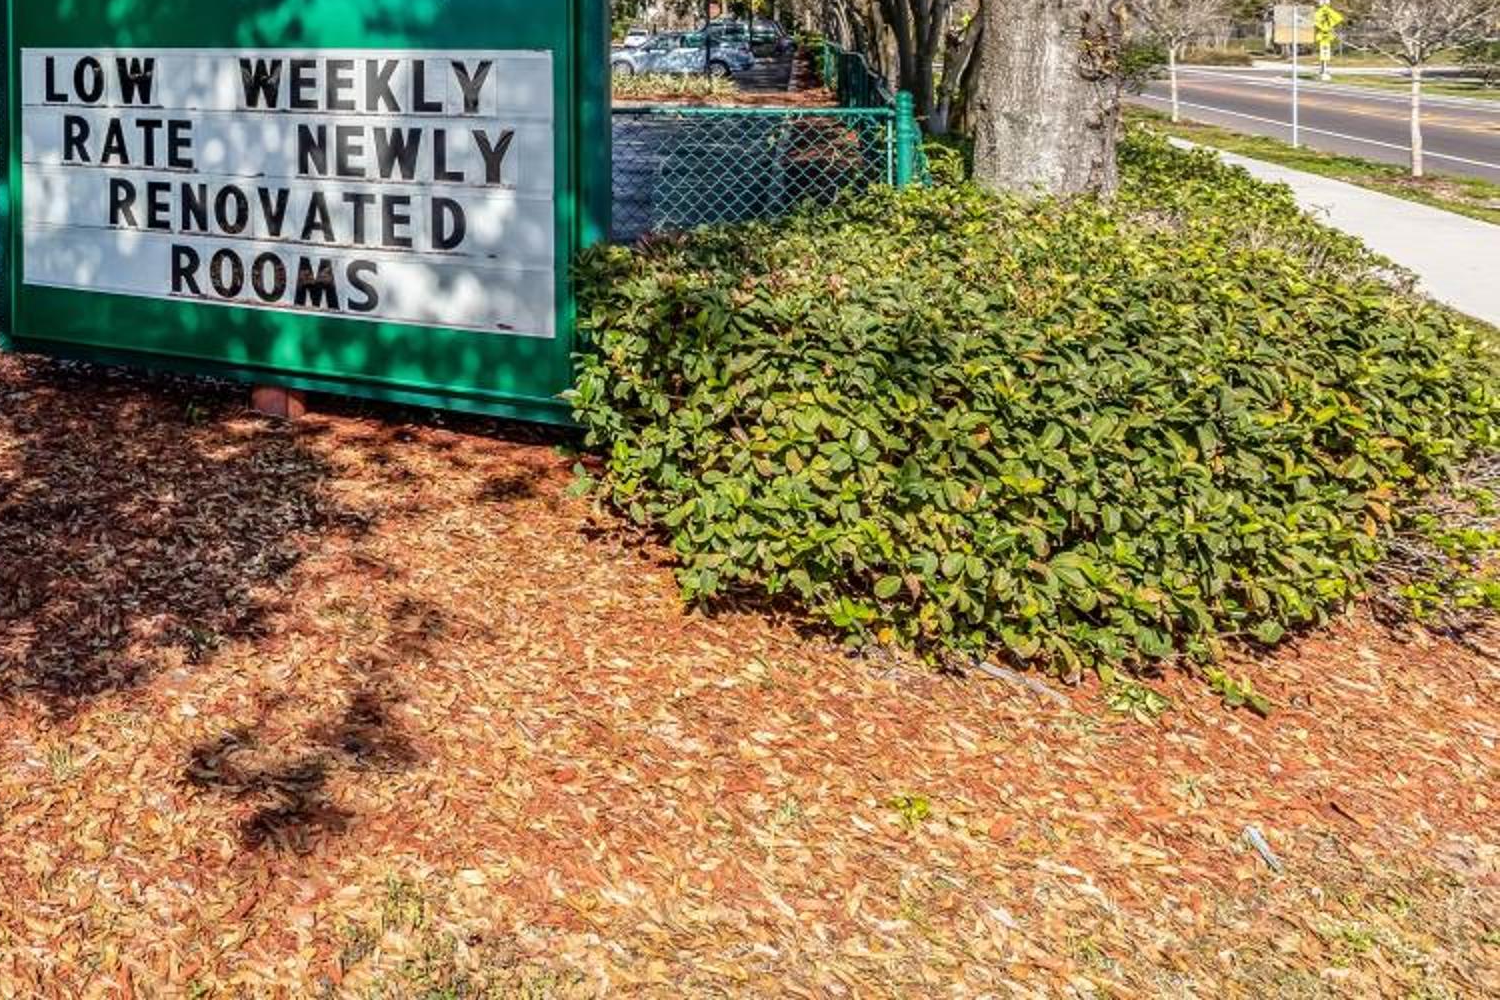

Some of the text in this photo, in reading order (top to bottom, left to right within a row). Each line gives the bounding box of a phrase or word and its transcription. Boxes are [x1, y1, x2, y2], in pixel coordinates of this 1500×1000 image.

[45, 55, 494, 113] LOW WEEKLY
[63, 115, 515, 184] RATE NEWLY
[109, 178, 467, 249] RENOVATED
[171, 244, 379, 312] ROOMS
